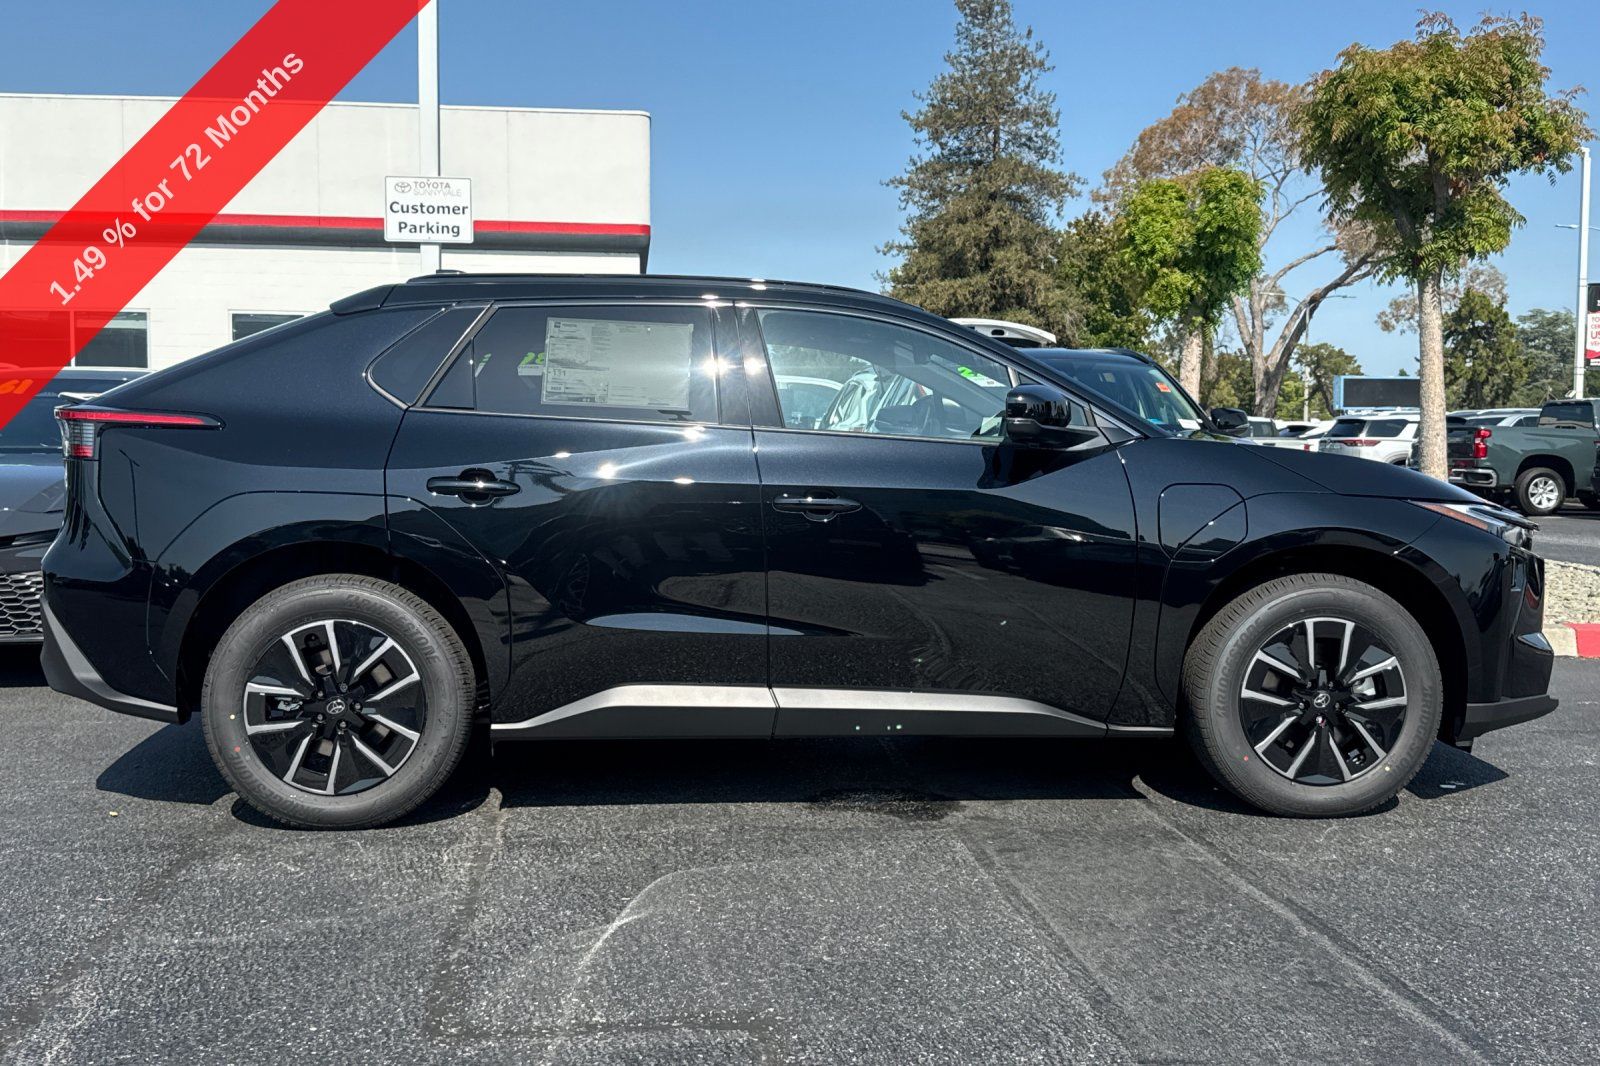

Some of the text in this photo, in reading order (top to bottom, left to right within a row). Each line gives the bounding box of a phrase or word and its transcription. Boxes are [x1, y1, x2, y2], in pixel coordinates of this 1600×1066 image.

[413, 181, 451, 189] TOYOTA
[413, 189, 462, 197] SUNNYVALE
[389, 201, 468, 215] Customer
[398, 221, 460, 237] Parking
